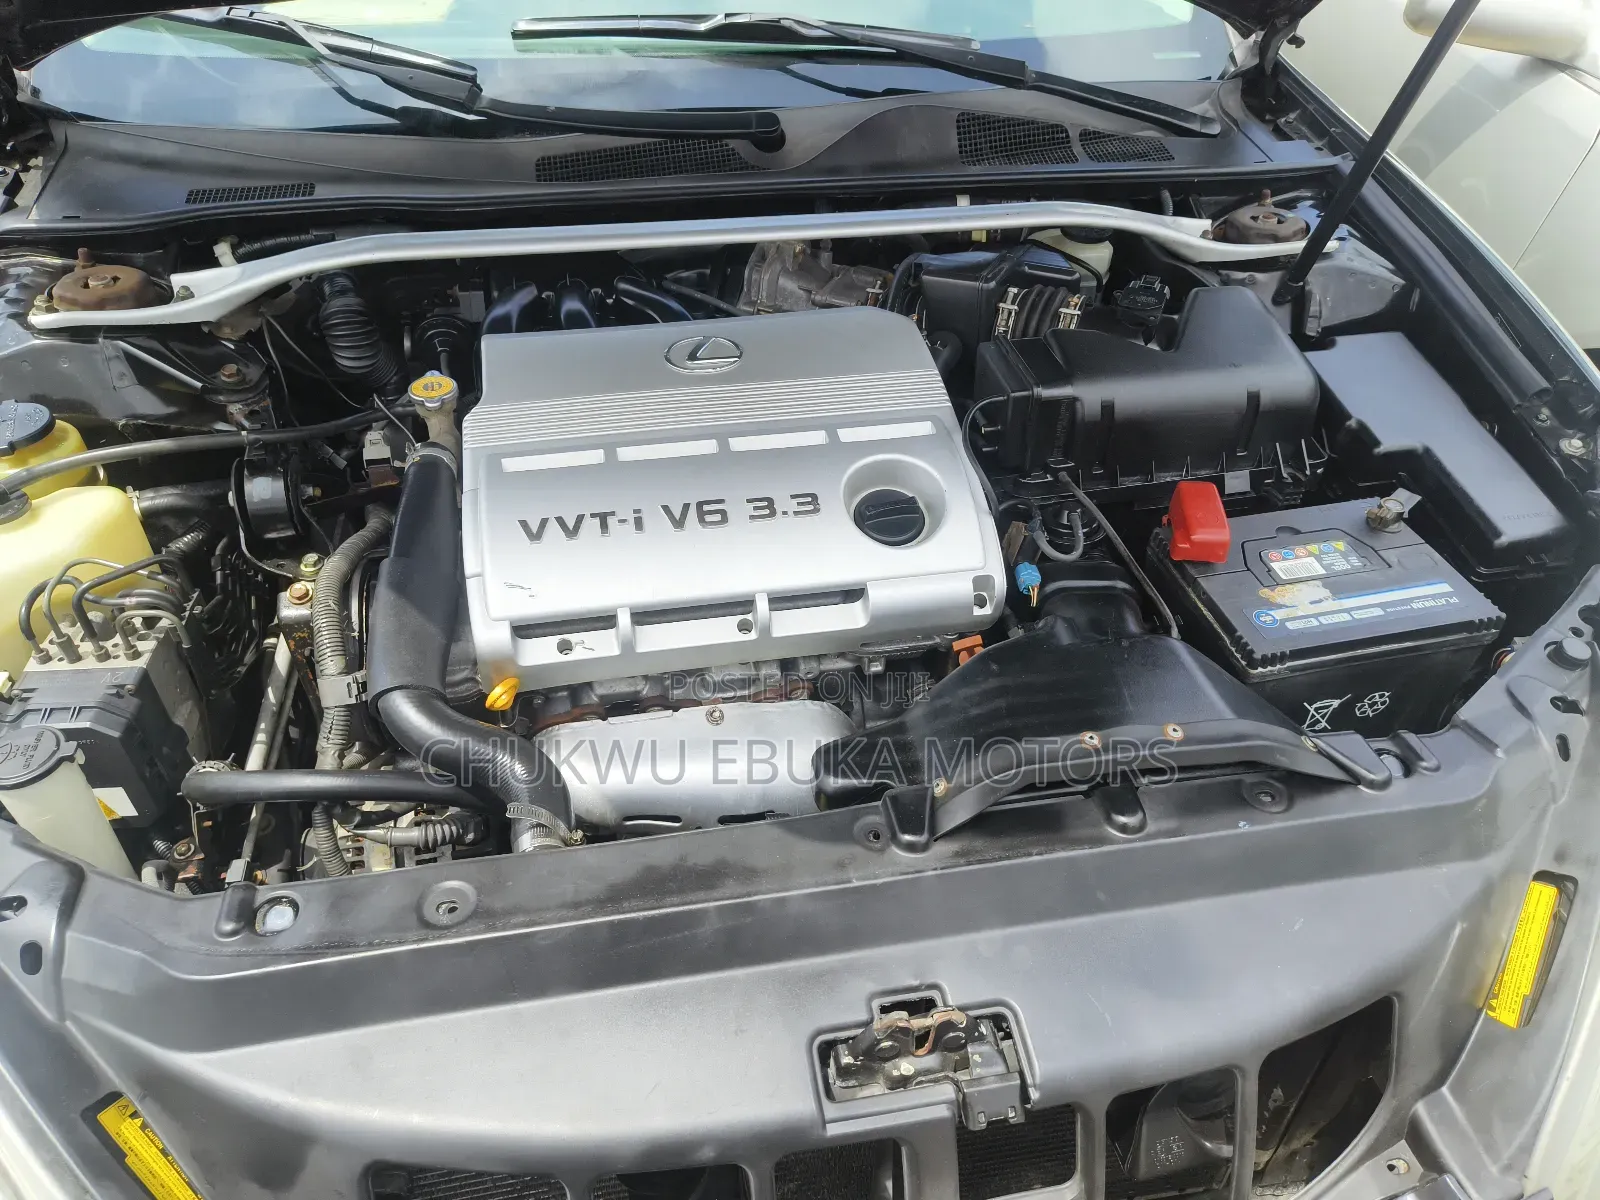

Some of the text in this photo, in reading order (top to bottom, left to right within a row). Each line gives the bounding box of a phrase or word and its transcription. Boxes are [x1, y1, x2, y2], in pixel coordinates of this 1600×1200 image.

[517, 492, 822, 545] VVT-i V6 3.3
[1411, 596, 1460, 610] PLATINUM
[144, 1128, 164, 1149] CAUTION
